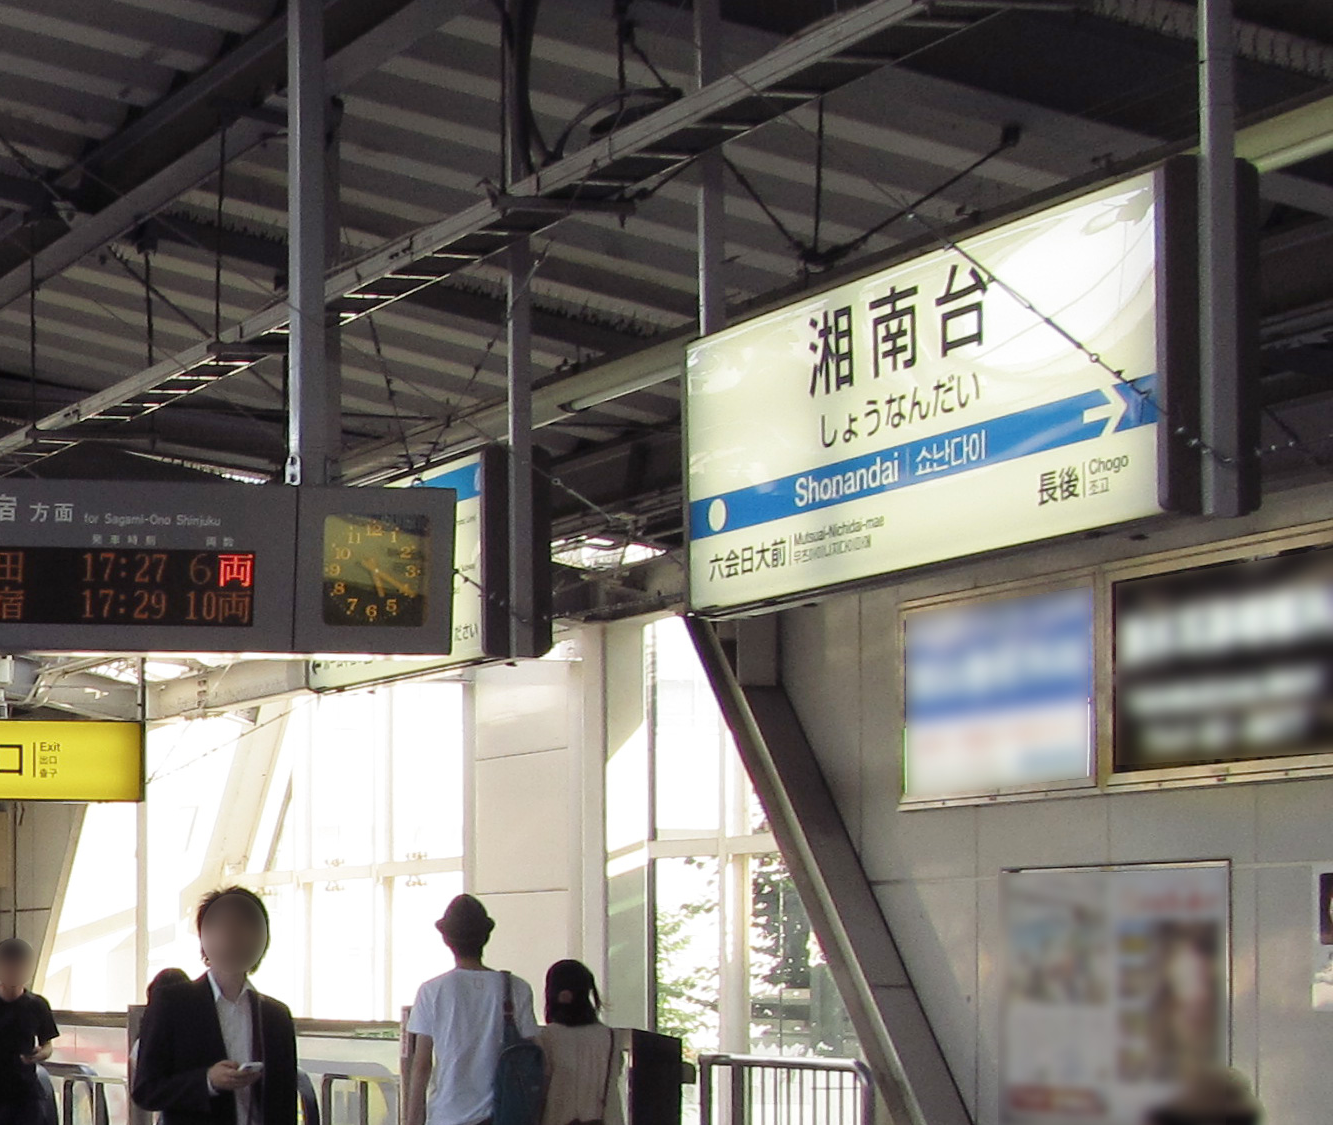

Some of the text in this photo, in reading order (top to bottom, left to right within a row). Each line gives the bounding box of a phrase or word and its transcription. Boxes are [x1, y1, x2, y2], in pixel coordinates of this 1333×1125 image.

[808, 264, 989, 398] 湘南台
[820, 371, 981, 448] しょうなんだい
[914, 429, 987, 477] 쇼난다이
[1088, 454, 1130, 476] Chogo
[793, 451, 900, 508] Shonandai
[1037, 465, 1080, 507] 長後
[29, 502, 74, 524] 方面
[176, 514, 222, 528] Shinjuku
[82, 552, 168, 583] 17:27
[708, 537, 788, 582] 六会日大前
[82, 589, 167, 620] 17:29
[39, 741, 61, 753] Exit
